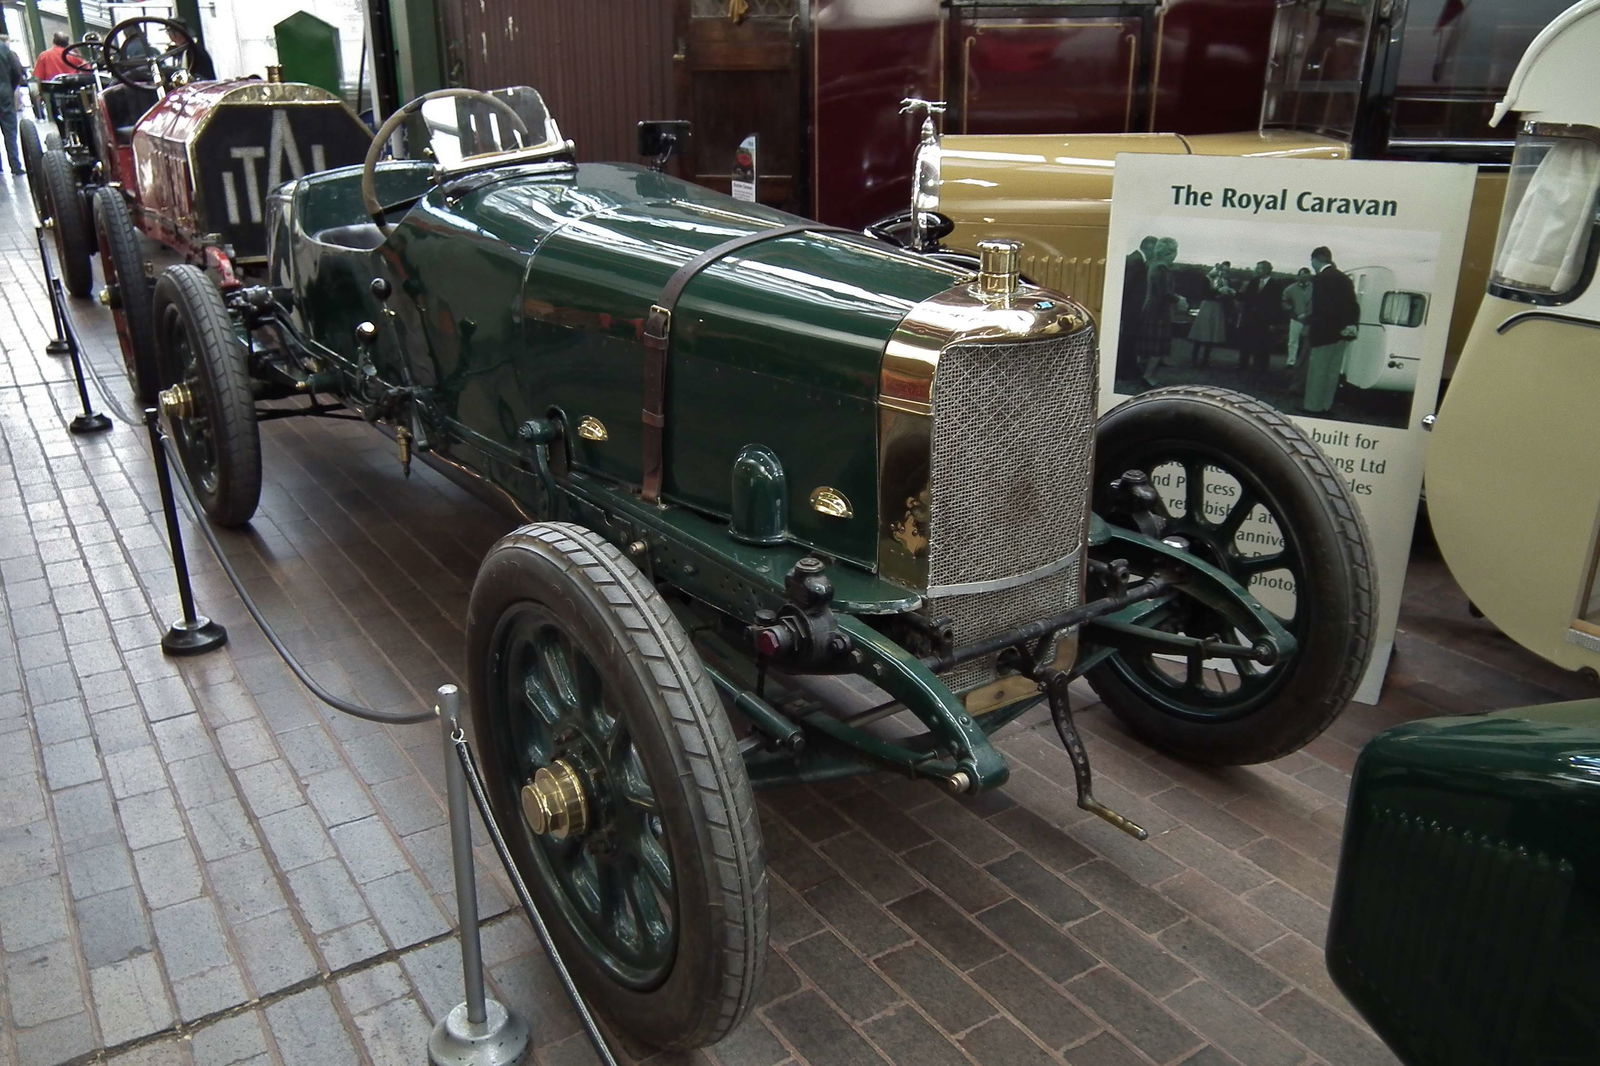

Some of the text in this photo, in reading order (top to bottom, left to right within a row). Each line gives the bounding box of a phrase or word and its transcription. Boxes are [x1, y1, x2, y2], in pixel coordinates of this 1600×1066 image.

[1171, 184, 1398, 216] The Royal Caravan
[1312, 427, 1379, 450] built for
[1330, 456, 1386, 474] ng Ltd
[1152, 473, 1171, 487] nd
[1347, 478, 1372, 495] les
[1236, 530, 1286, 548] annive
[1249, 571, 1297, 595] photo
